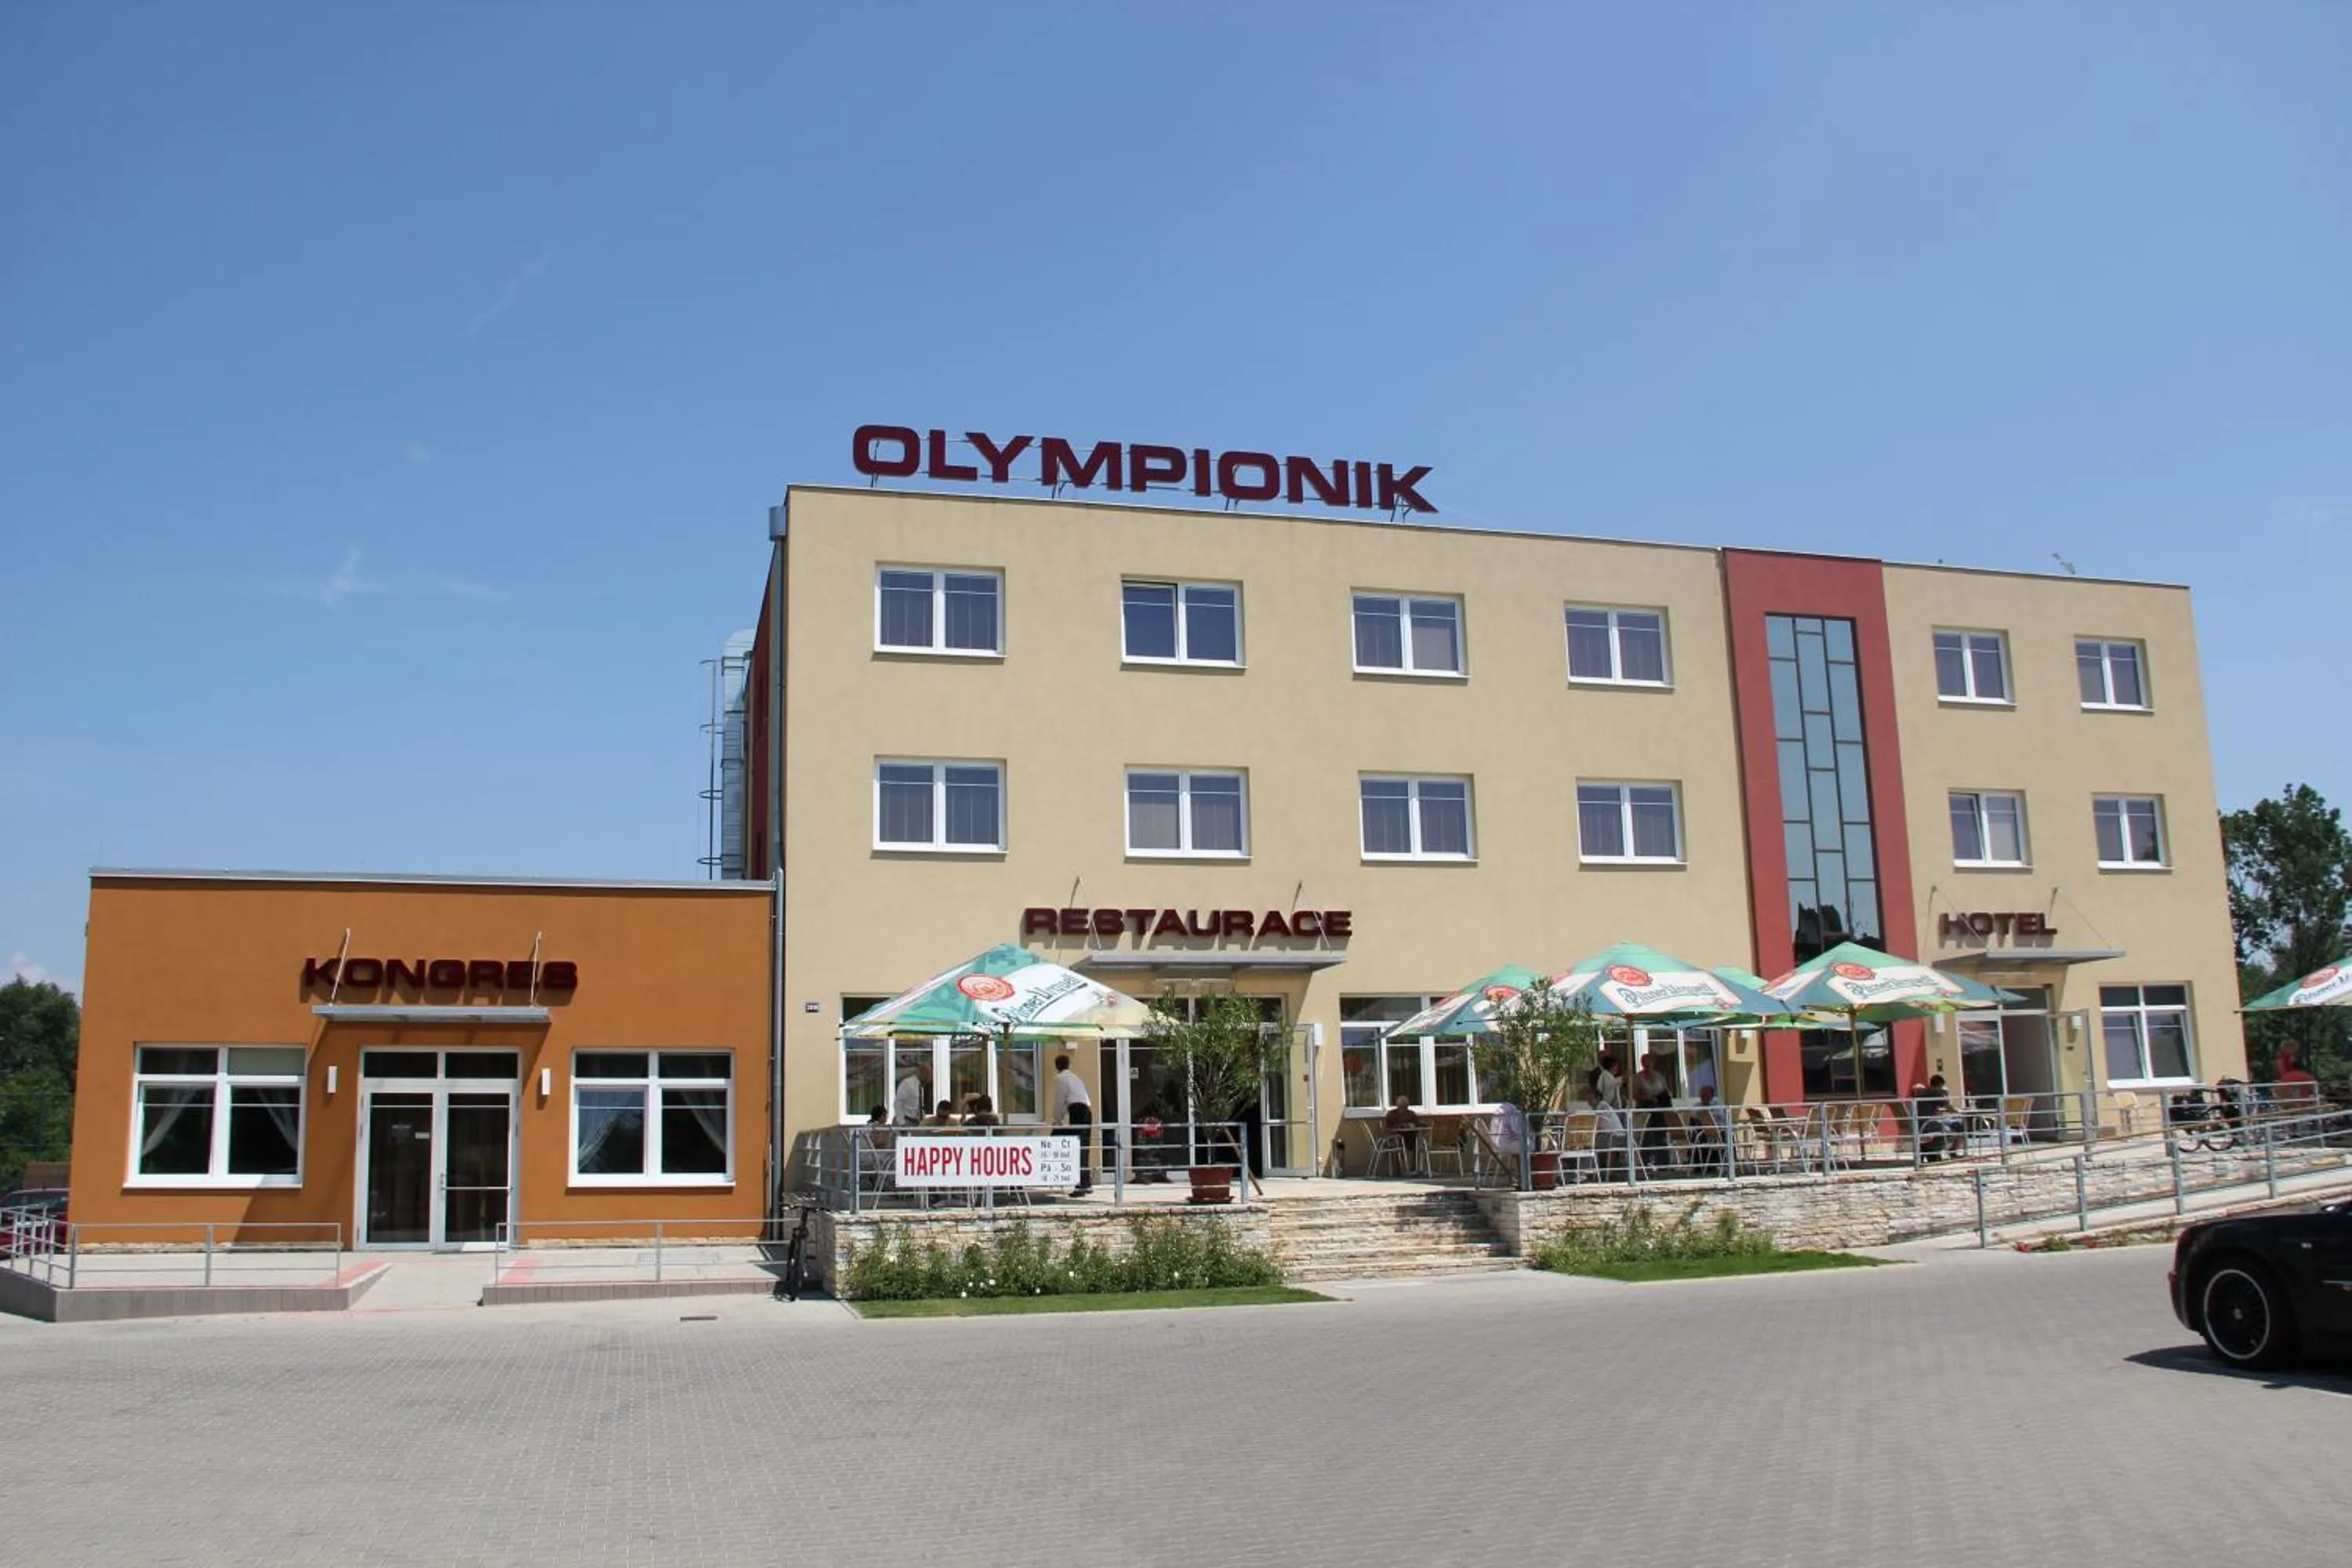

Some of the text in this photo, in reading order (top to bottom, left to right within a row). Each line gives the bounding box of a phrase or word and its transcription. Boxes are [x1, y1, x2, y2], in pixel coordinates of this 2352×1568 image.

[852, 424, 1439, 514] OLYMPIONIK
[1023, 907, 1352, 938] RESTAURACE
[1939, 912, 2058, 935] HOTEL
[304, 957, 578, 990] KONGRES
[904, 1145, 1032, 1176] HAPPY HOURS
